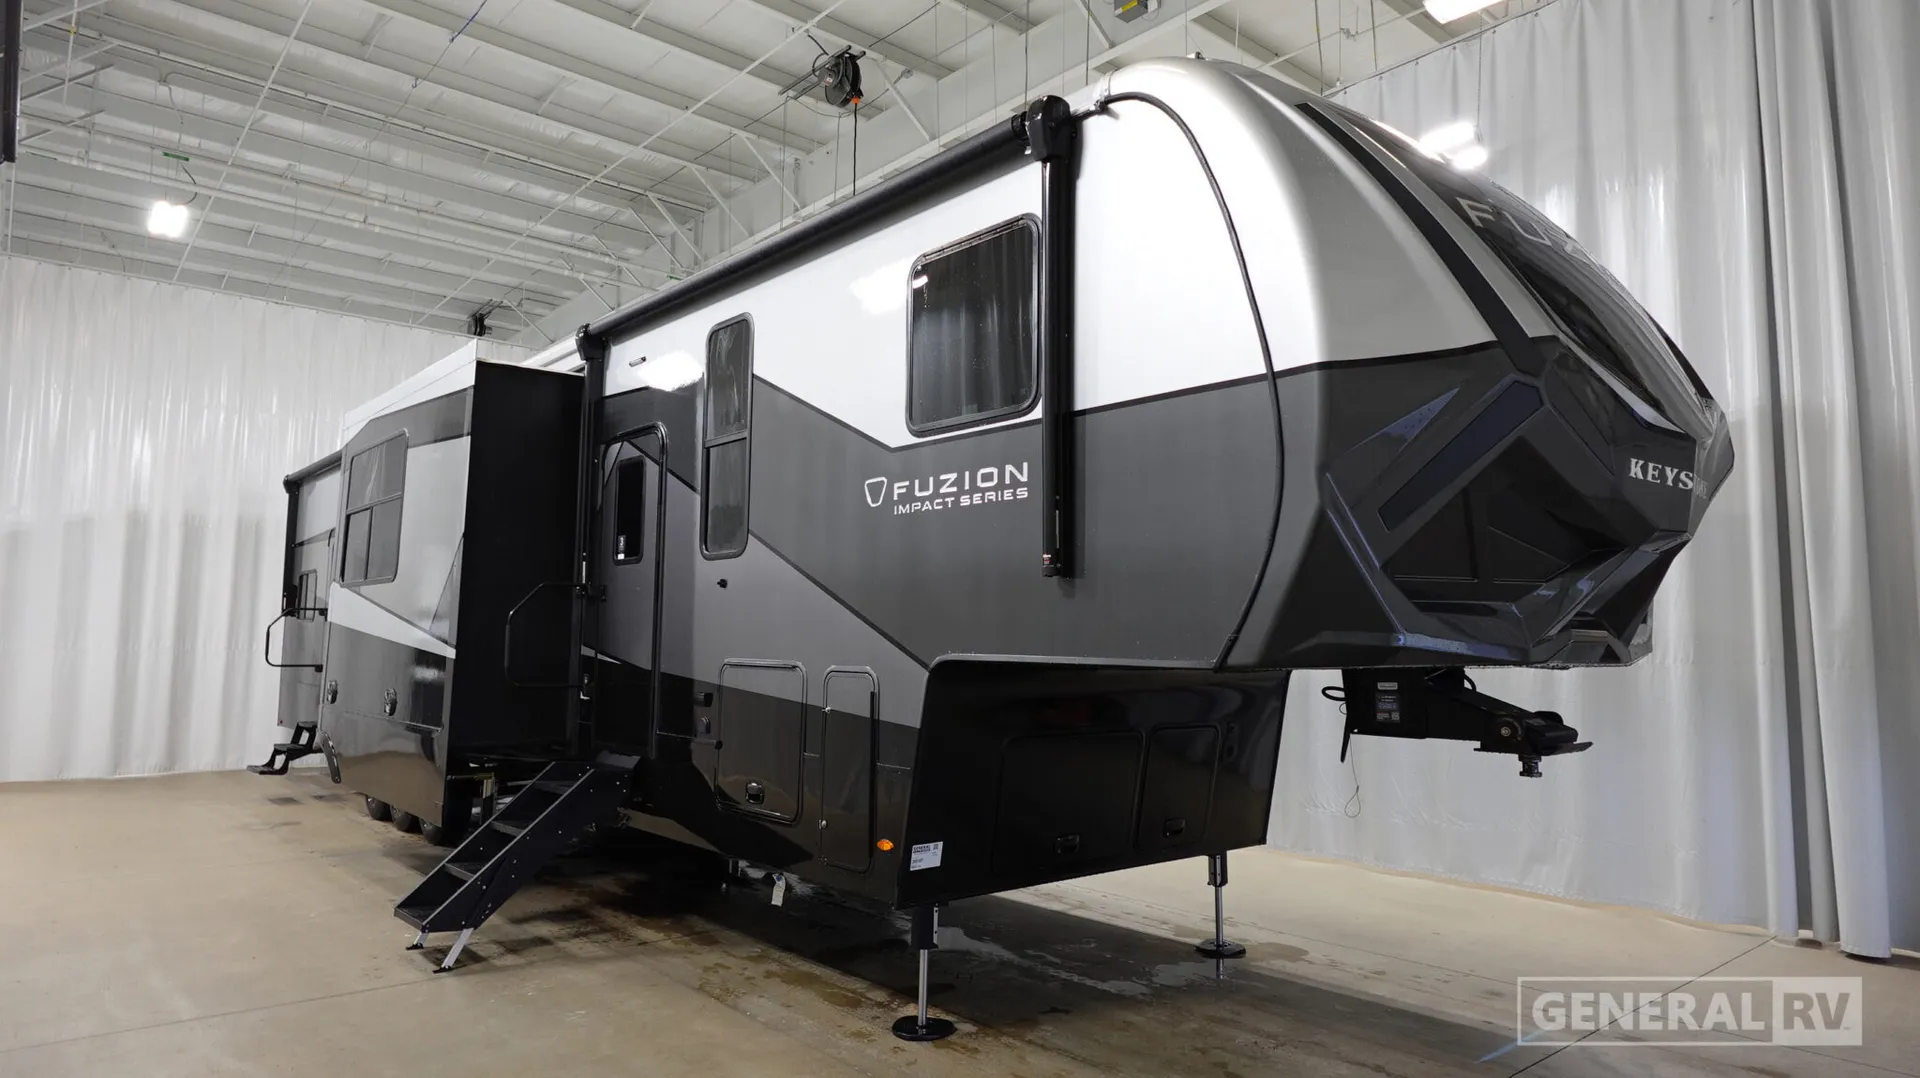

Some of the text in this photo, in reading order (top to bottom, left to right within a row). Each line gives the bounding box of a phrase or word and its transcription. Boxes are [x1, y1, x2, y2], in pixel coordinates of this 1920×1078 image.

[893, 462, 1028, 500] FUZION
[1629, 458, 1706, 497] KEYS
[894, 487, 1028, 515] IMPACT SERIES
